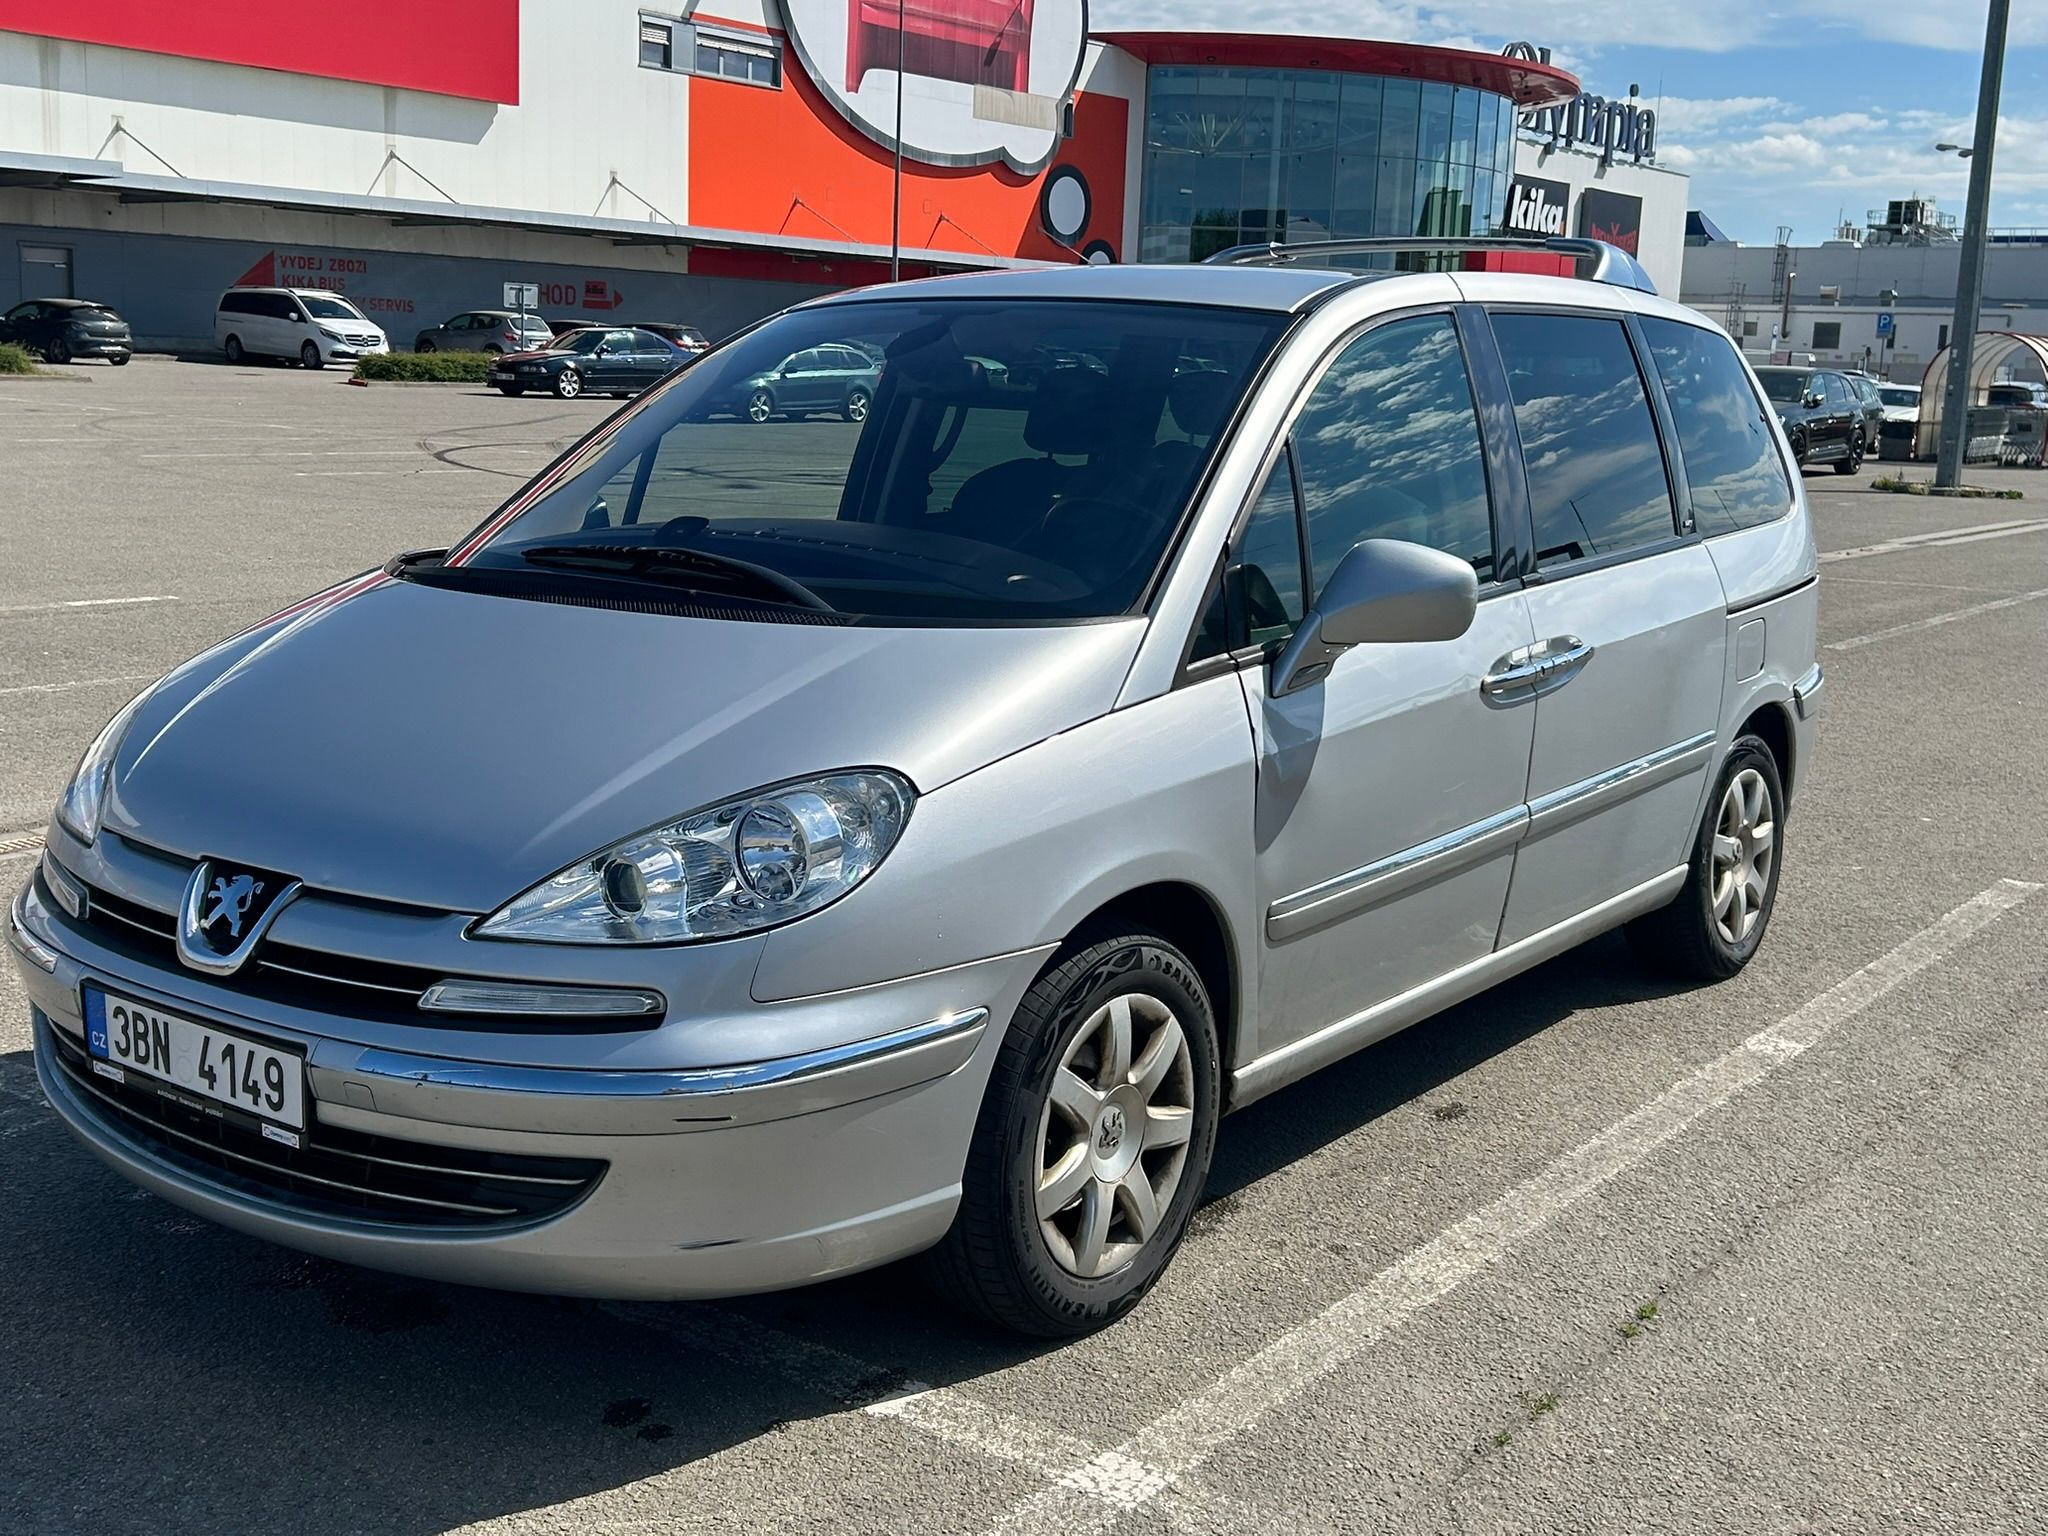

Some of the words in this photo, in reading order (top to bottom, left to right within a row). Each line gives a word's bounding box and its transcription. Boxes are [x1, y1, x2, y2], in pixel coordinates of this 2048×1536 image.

[1509, 184, 1564, 235] kika
[282, 274, 315, 289] KIKA
[320, 276, 345, 290] BUS
[369, 298, 415, 313] SERVIS
[1880, 315, 1890, 327] P
[91, 1030, 107, 1050] CZ
[112, 1005, 171, 1075] 3BN
[198, 1035, 285, 1112] 4149
